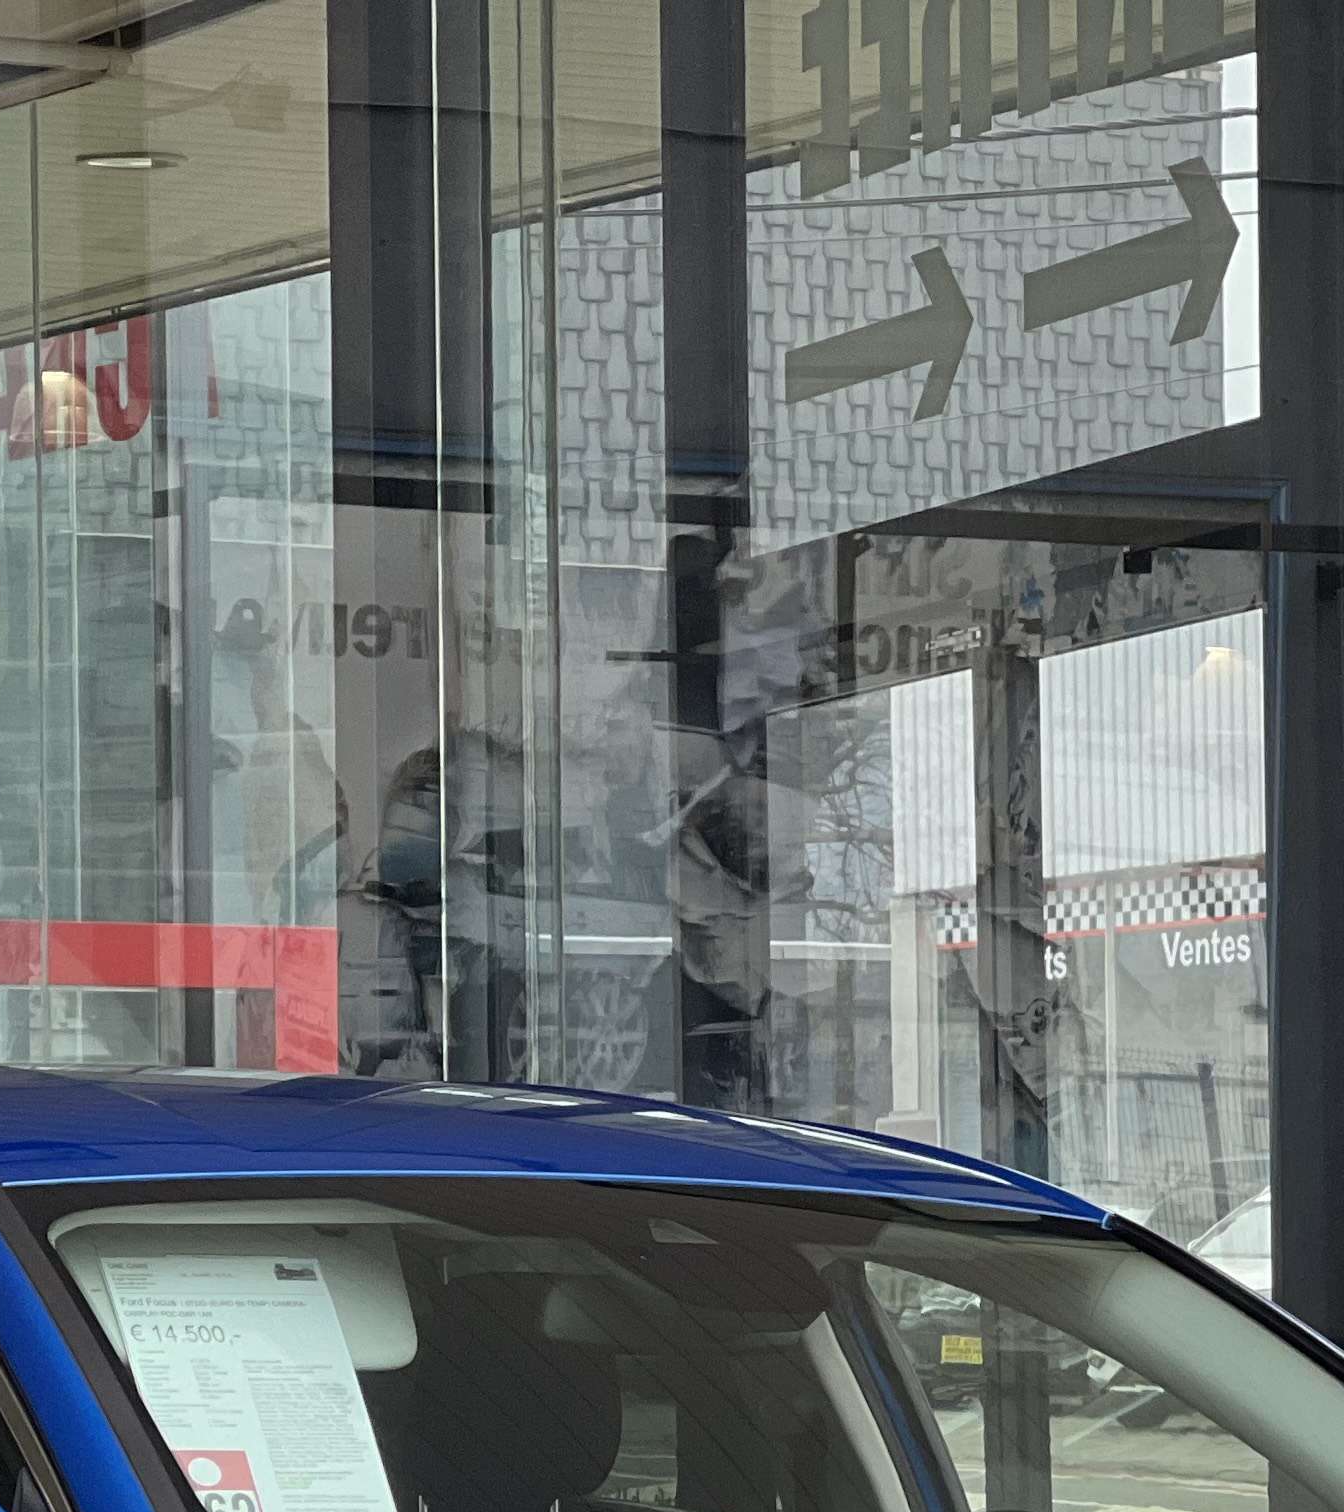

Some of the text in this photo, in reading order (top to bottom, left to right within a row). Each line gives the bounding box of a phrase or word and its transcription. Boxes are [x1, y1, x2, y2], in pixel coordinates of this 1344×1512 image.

[1161, 928, 1252, 968] Ventes
[120, 1297, 144, 1307] Ford
[147, 1297, 177, 1307] Focus
[130, 1324, 146, 1342] €
